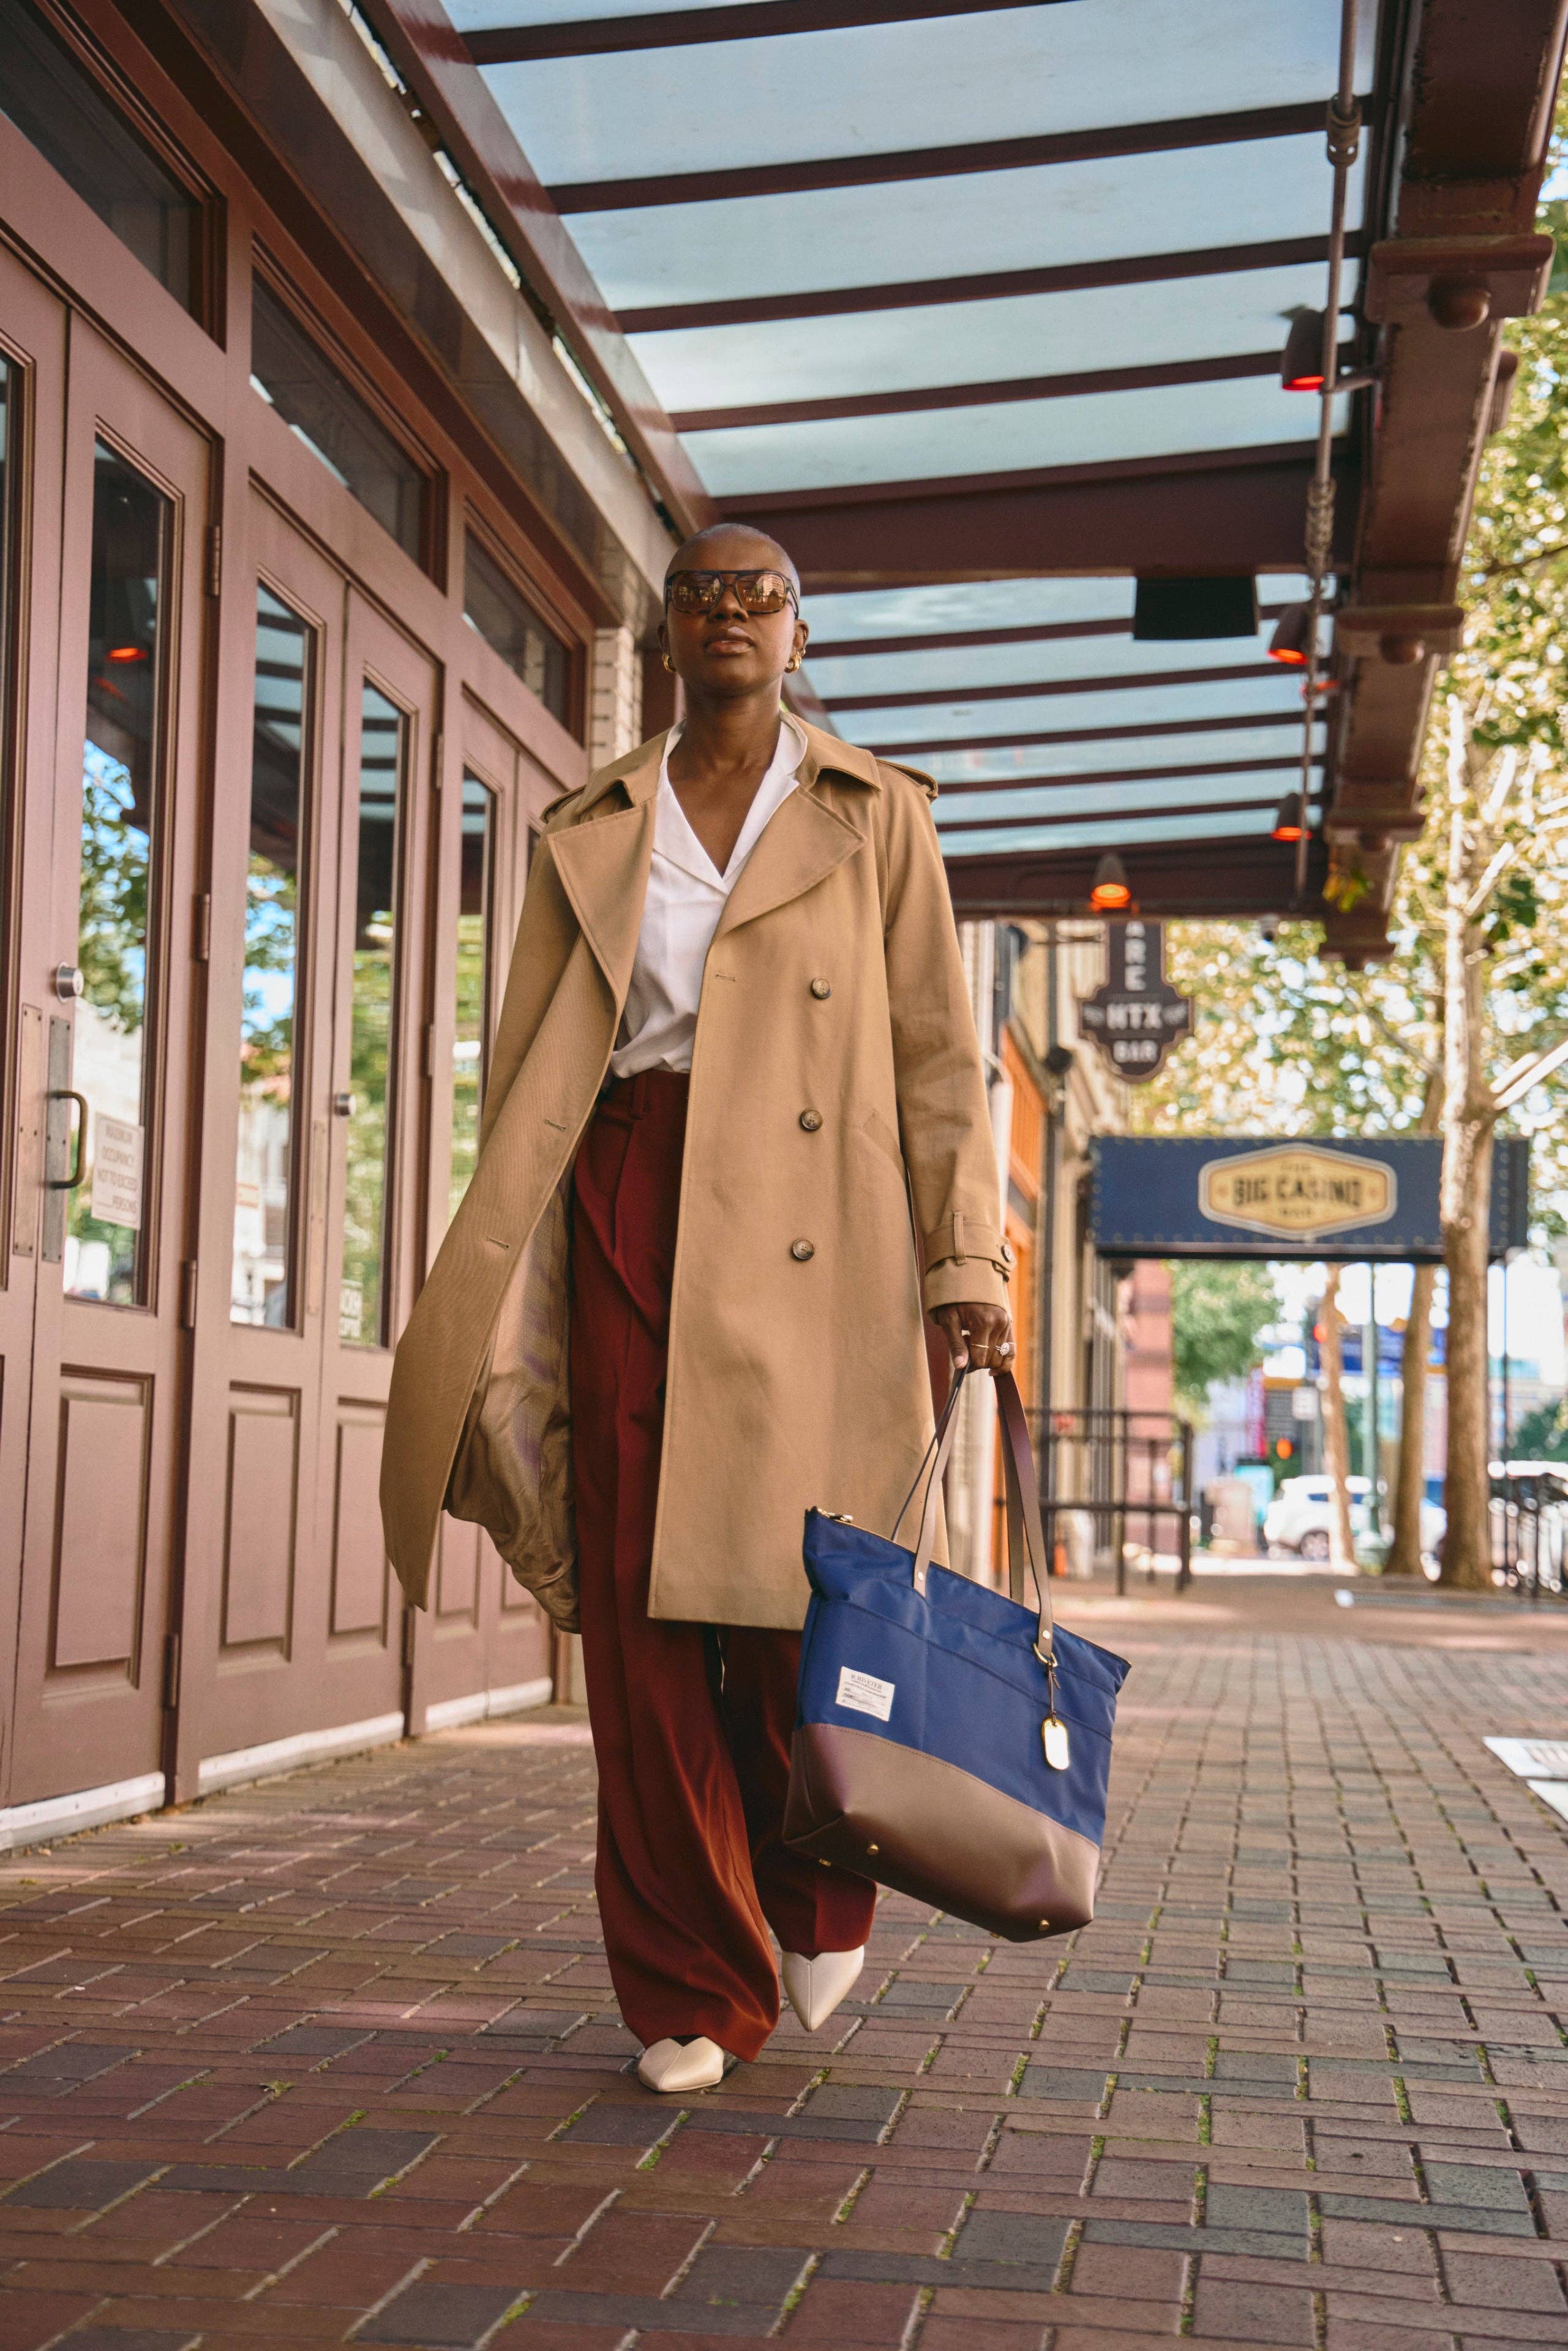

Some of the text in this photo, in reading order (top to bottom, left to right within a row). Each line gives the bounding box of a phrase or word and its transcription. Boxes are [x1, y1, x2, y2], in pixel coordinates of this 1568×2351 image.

[1113, 1040, 1157, 1063] BAR
[102, 1146, 134, 1167] OCCUPANCY
[98, 1168, 137, 1191] NOT TO EXCEED
[1234, 1177, 1361, 1207] BIG CASINO
[113, 1195, 137, 1214] PERSONS
